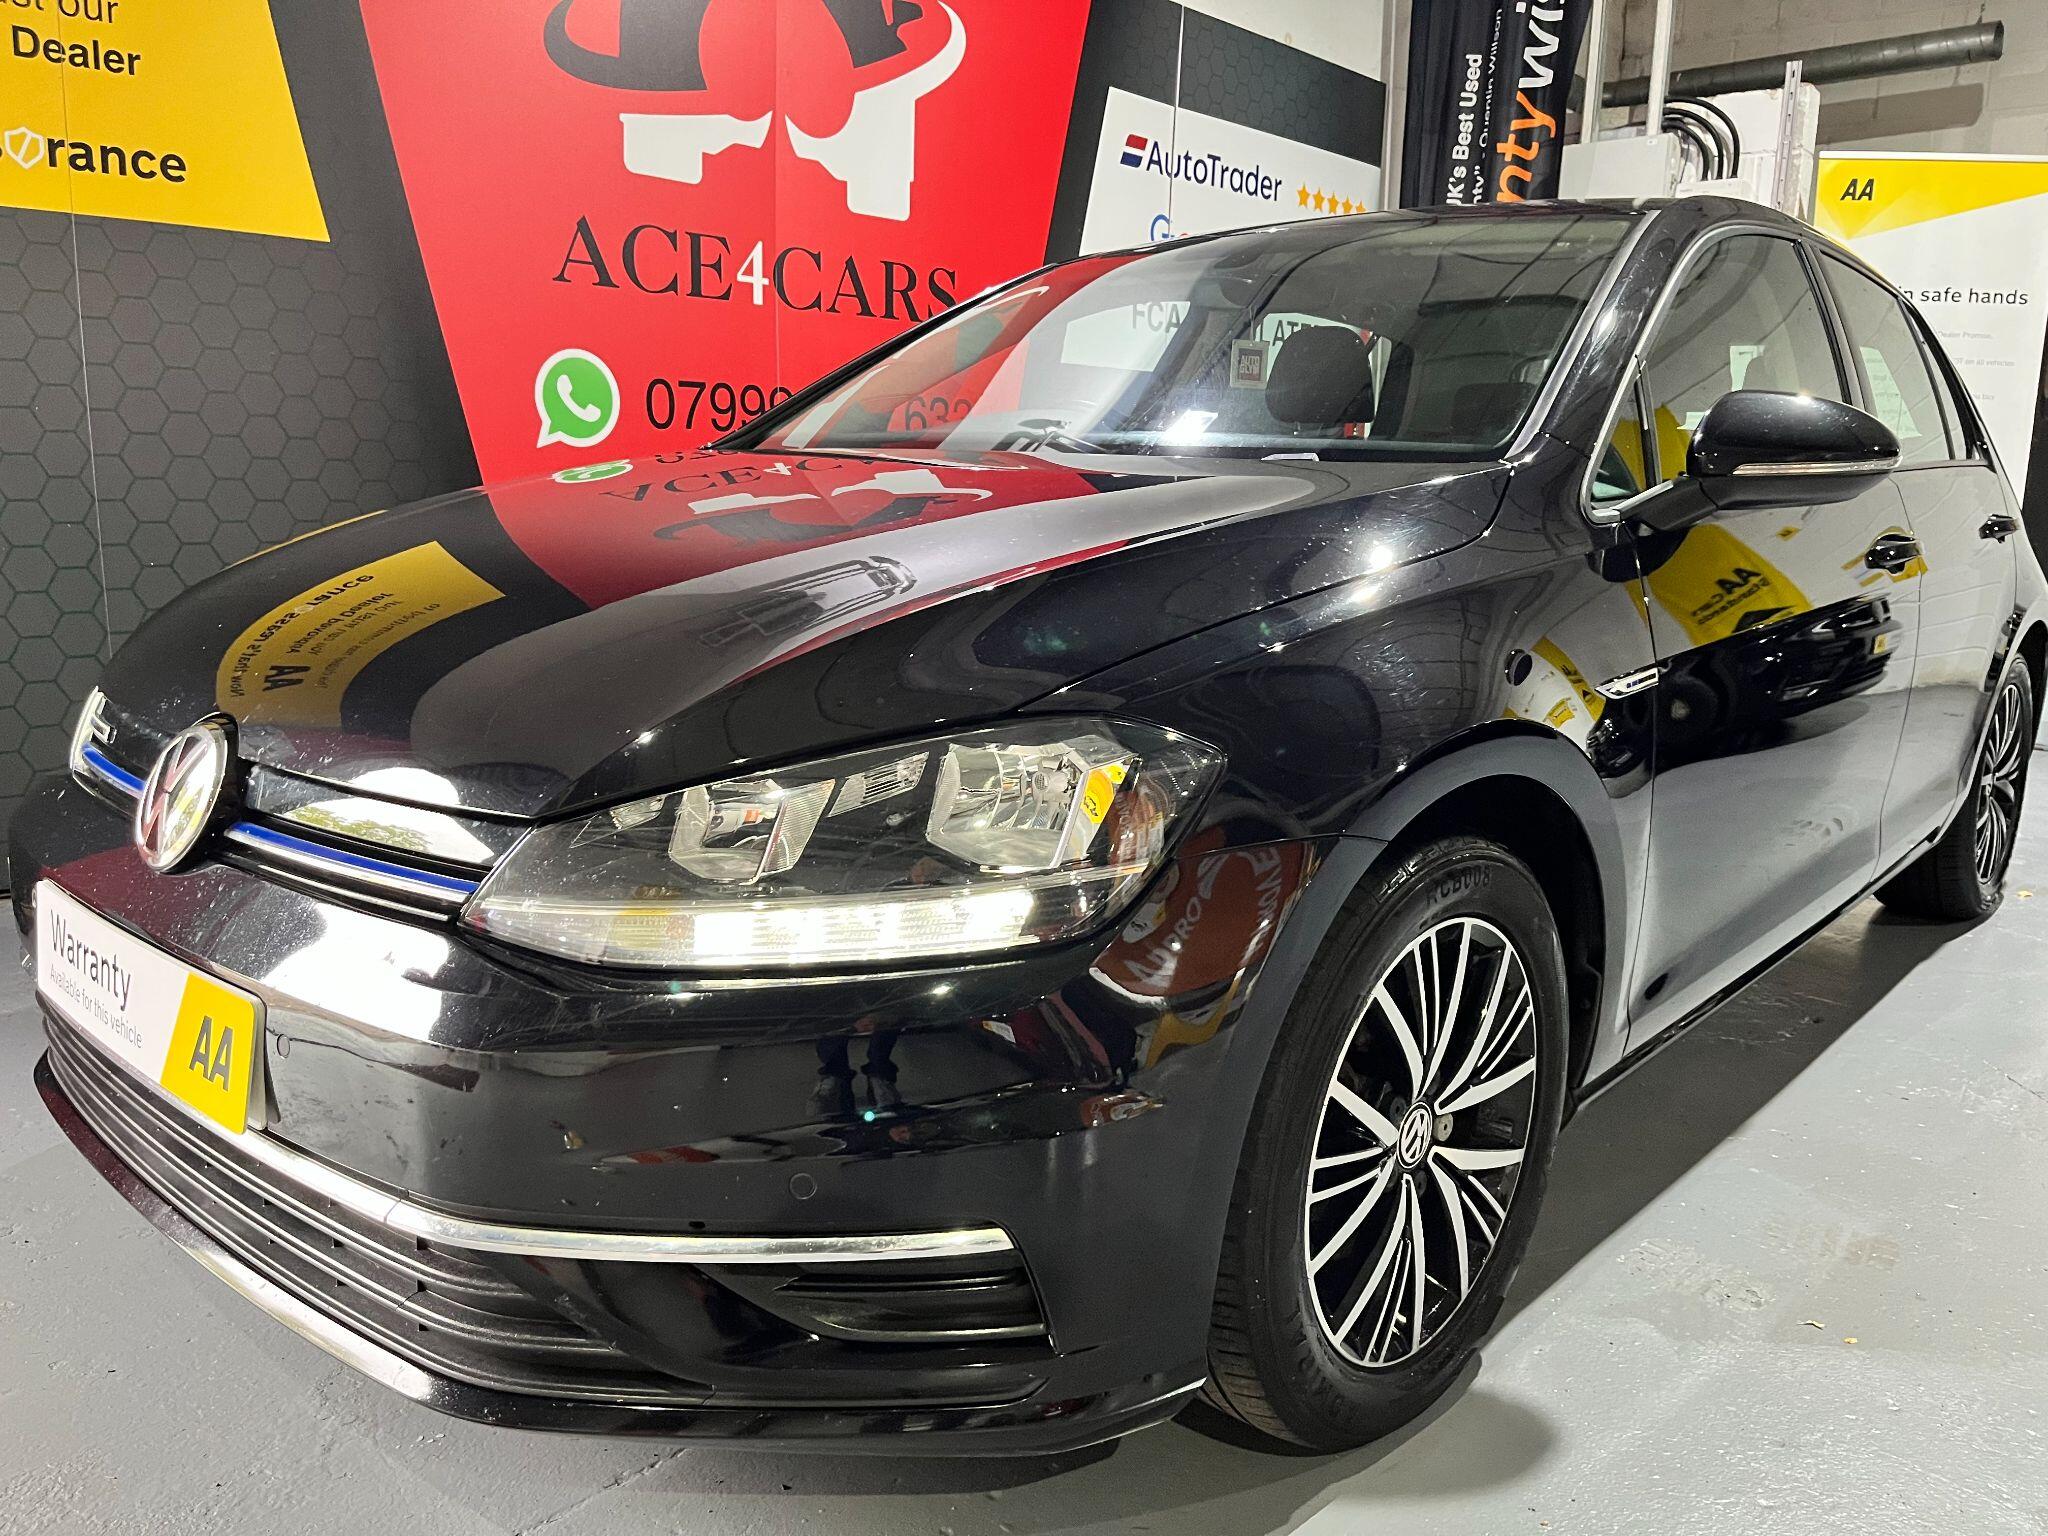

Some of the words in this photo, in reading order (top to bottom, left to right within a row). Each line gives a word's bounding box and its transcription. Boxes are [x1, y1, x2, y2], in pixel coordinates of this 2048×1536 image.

[11, 25, 142, 77] Dealer
[1458, 53, 1484, 108] Used
[1451, 112, 1476, 161] Best
[1145, 139, 1283, 203] AutoTrader
[1839, 177, 1876, 202] AA
[551, 214, 959, 324] ACE4CARS
[1920, 286, 1963, 303] safe
[1968, 286, 2030, 306] hands
[50, 908, 132, 1011] Warranty
[50, 964, 81, 1004] Available
[81, 990, 94, 1013] for
[93, 997, 110, 1026] this
[109, 1011, 144, 1049] vehicle
[188, 1014, 234, 1092] AA
